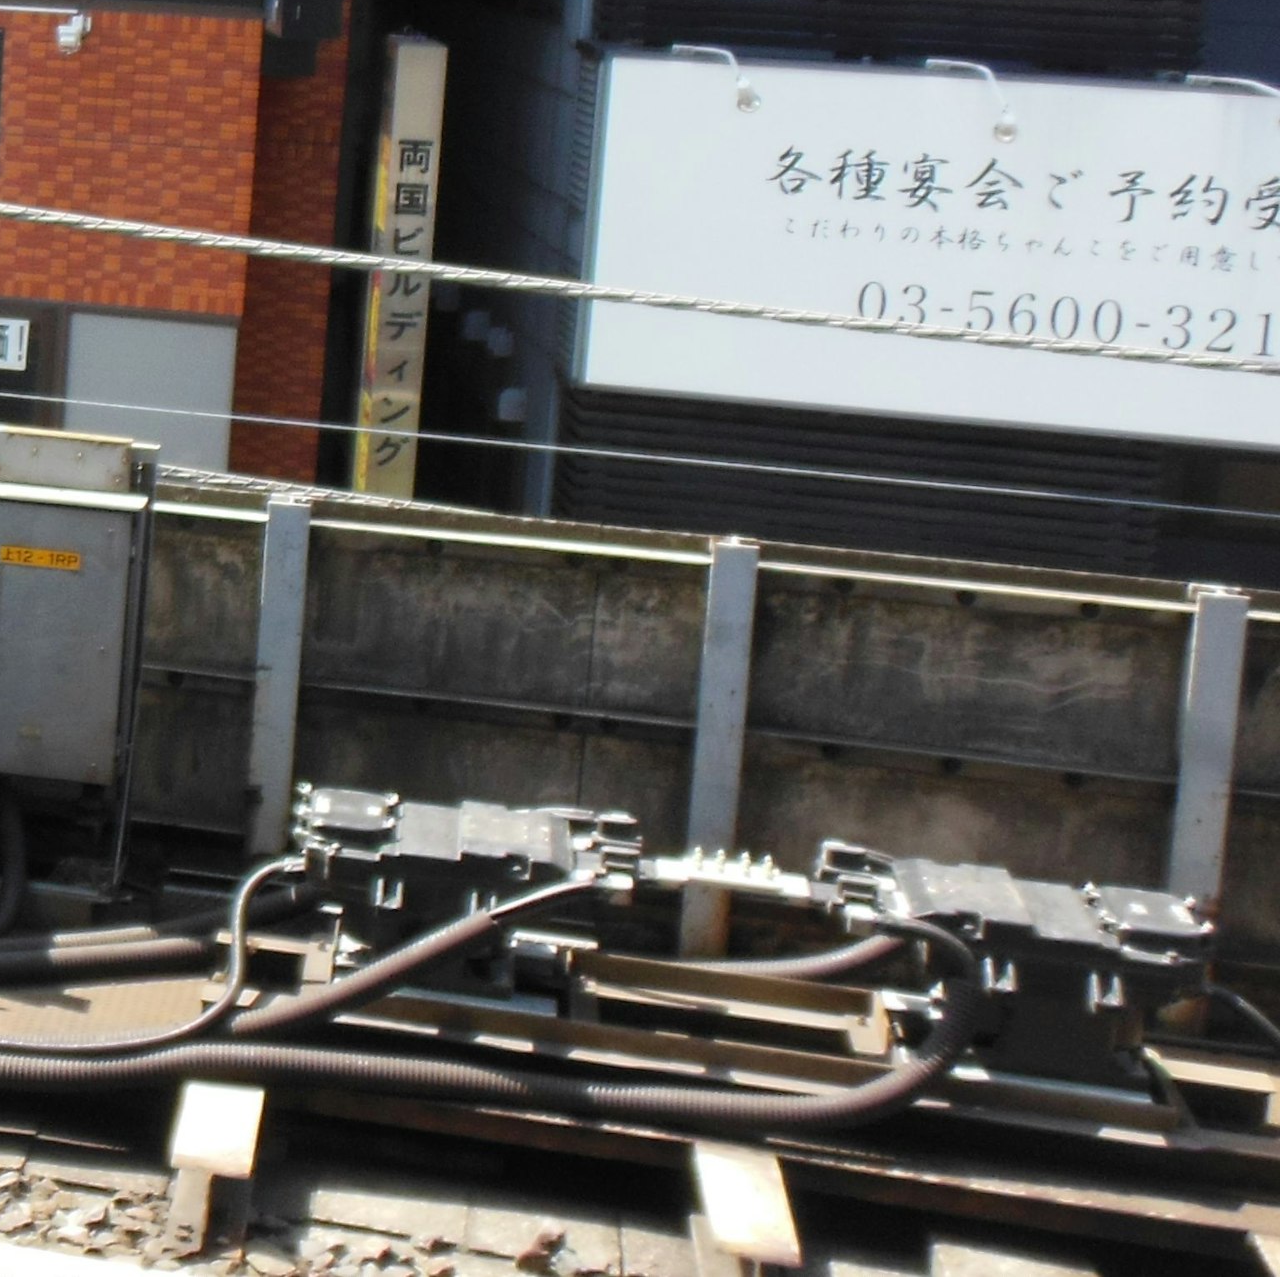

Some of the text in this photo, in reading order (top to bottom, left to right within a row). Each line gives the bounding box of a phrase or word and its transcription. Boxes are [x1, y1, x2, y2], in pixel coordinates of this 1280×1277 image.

[374, 139, 435, 467] 両国ビルディング
[784, 218, 1280, 272] こだわりの本格ちゃんこをご用意し
